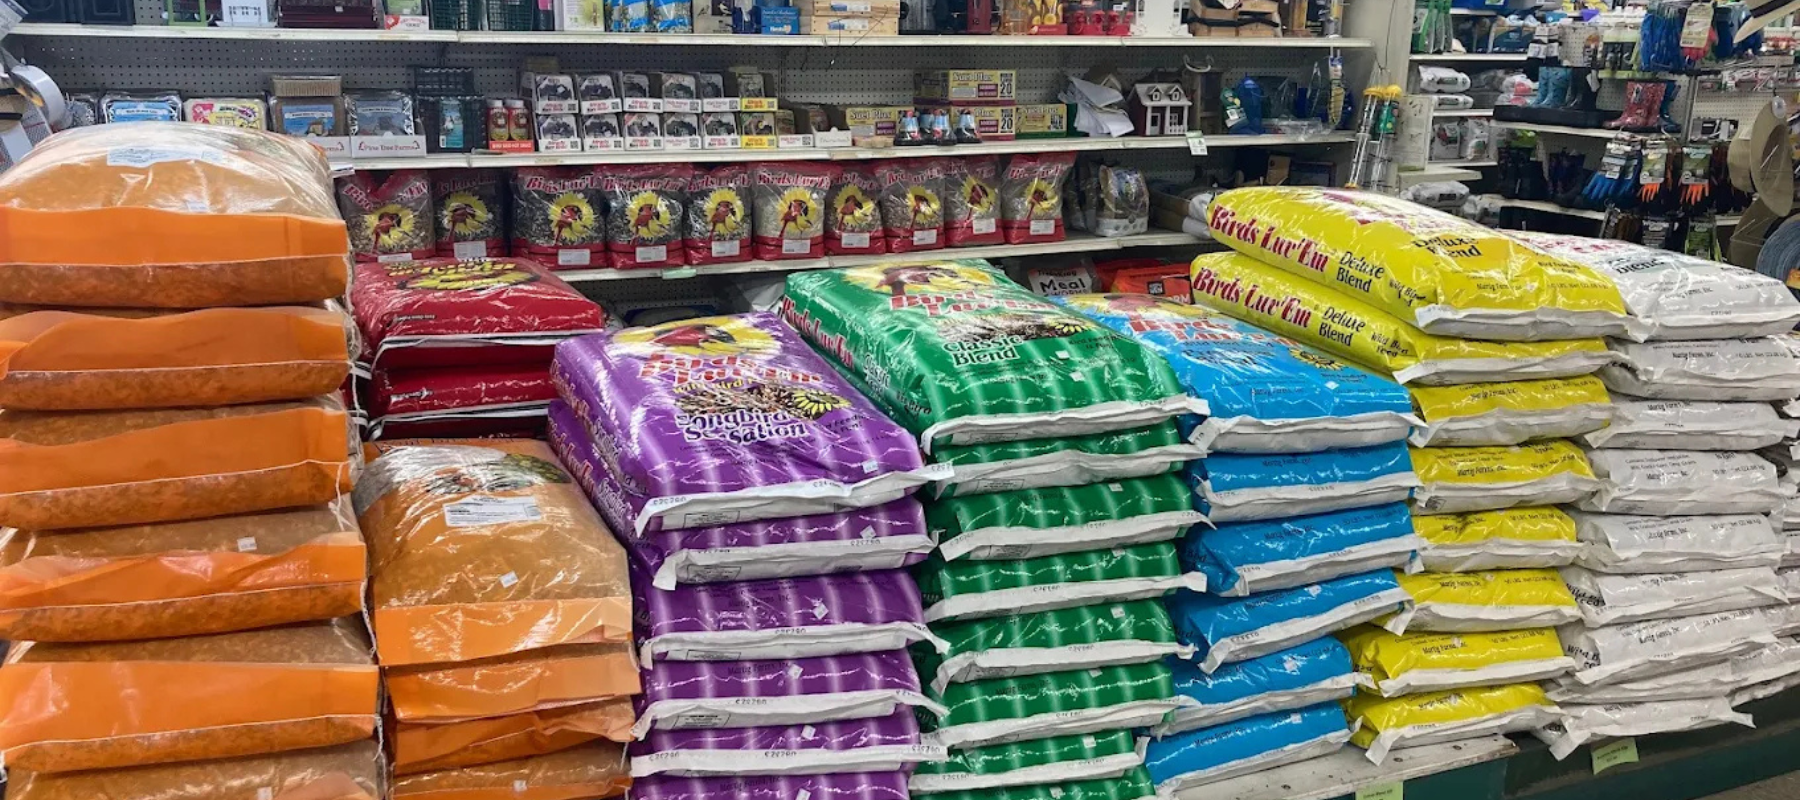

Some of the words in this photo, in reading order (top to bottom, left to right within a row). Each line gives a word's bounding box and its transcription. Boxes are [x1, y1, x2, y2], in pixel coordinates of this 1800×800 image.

[1000, 83, 1012, 95] 20
[1001, 118, 1013, 130] 20
[1209, 203, 1259, 246] Birds
[1338, 251, 1386, 280] Deluxe
[1039, 278, 1086, 293] Meal
[1192, 268, 1243, 305] Birds
[1335, 267, 1373, 293] Blend
[781, 294, 811, 336] Birds
[1322, 306, 1367, 333] Deluxe
[943, 335, 1023, 353] Classic
[1318, 323, 1354, 347] Blend
[953, 346, 1021, 367] Blend
